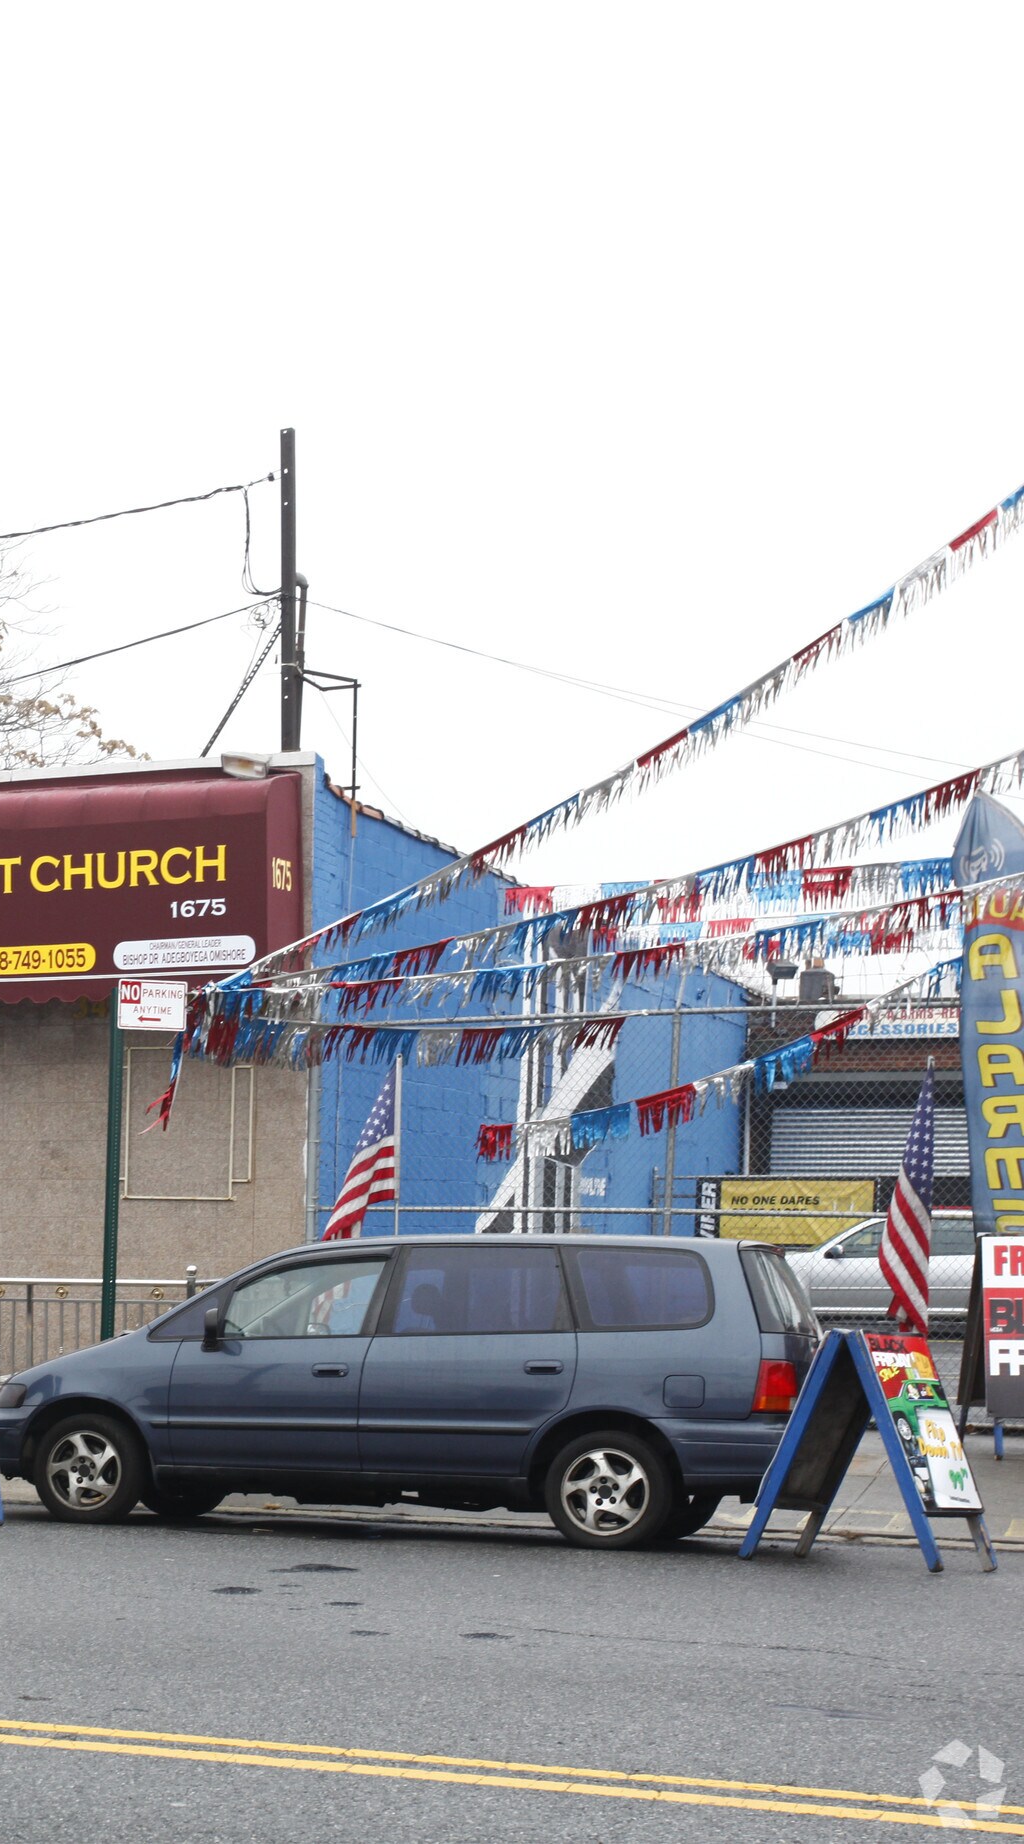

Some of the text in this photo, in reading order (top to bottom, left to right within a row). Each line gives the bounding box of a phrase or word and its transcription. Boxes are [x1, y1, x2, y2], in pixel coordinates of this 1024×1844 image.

[29, 844, 227, 893] CHURCH
[272, 856, 293, 893] 1675
[170, 898, 227, 919] 1675
[201, 939, 222, 947] LEADER
[122, 949, 247, 966] BISHOP DR ADEGBOYEGA OMISHORE
[120, 982, 183, 1001] NO PARKING
[133, 1005, 172, 1015] ANYTIME
[731, 1195, 820, 1205] NO ONE DARES
[868, 1337, 906, 1351] BLACK
[879, 1365, 900, 1382] SALE
